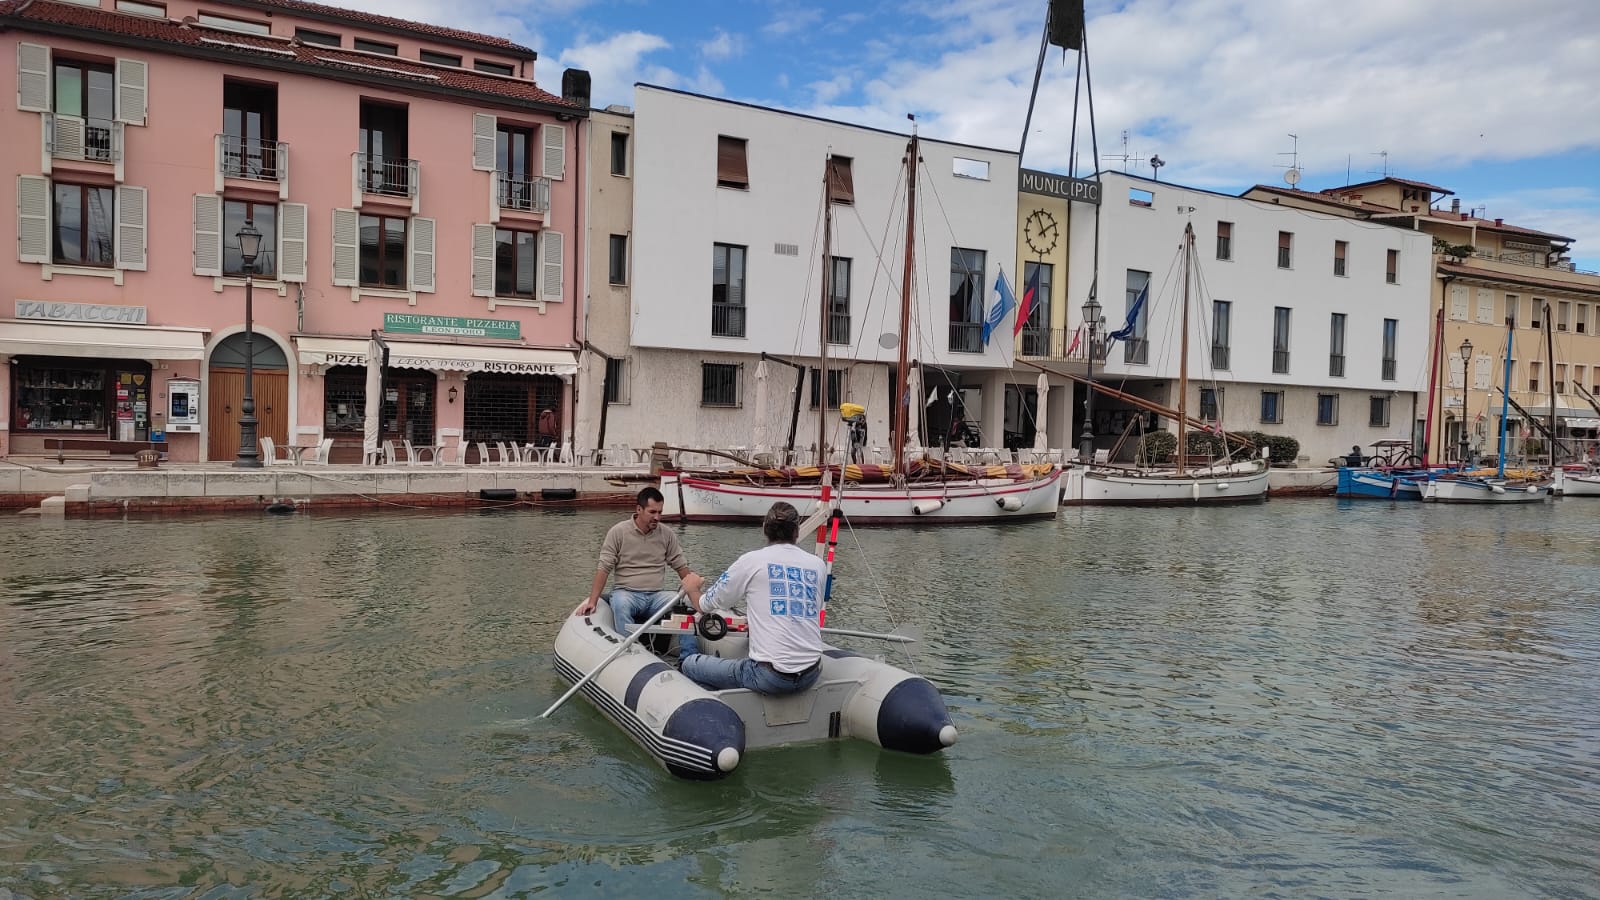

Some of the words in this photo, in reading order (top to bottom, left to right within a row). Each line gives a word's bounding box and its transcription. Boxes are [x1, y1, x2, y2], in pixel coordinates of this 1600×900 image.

[17, 302, 145, 322] TABACCHI
[387, 314, 458, 327] RISTORANTE
[466, 319, 518, 330] PIZZERIA
[424, 326, 451, 334] LEON
[326, 354, 368, 365] PIZZE
[484, 362, 556, 373] RISTORANTE
